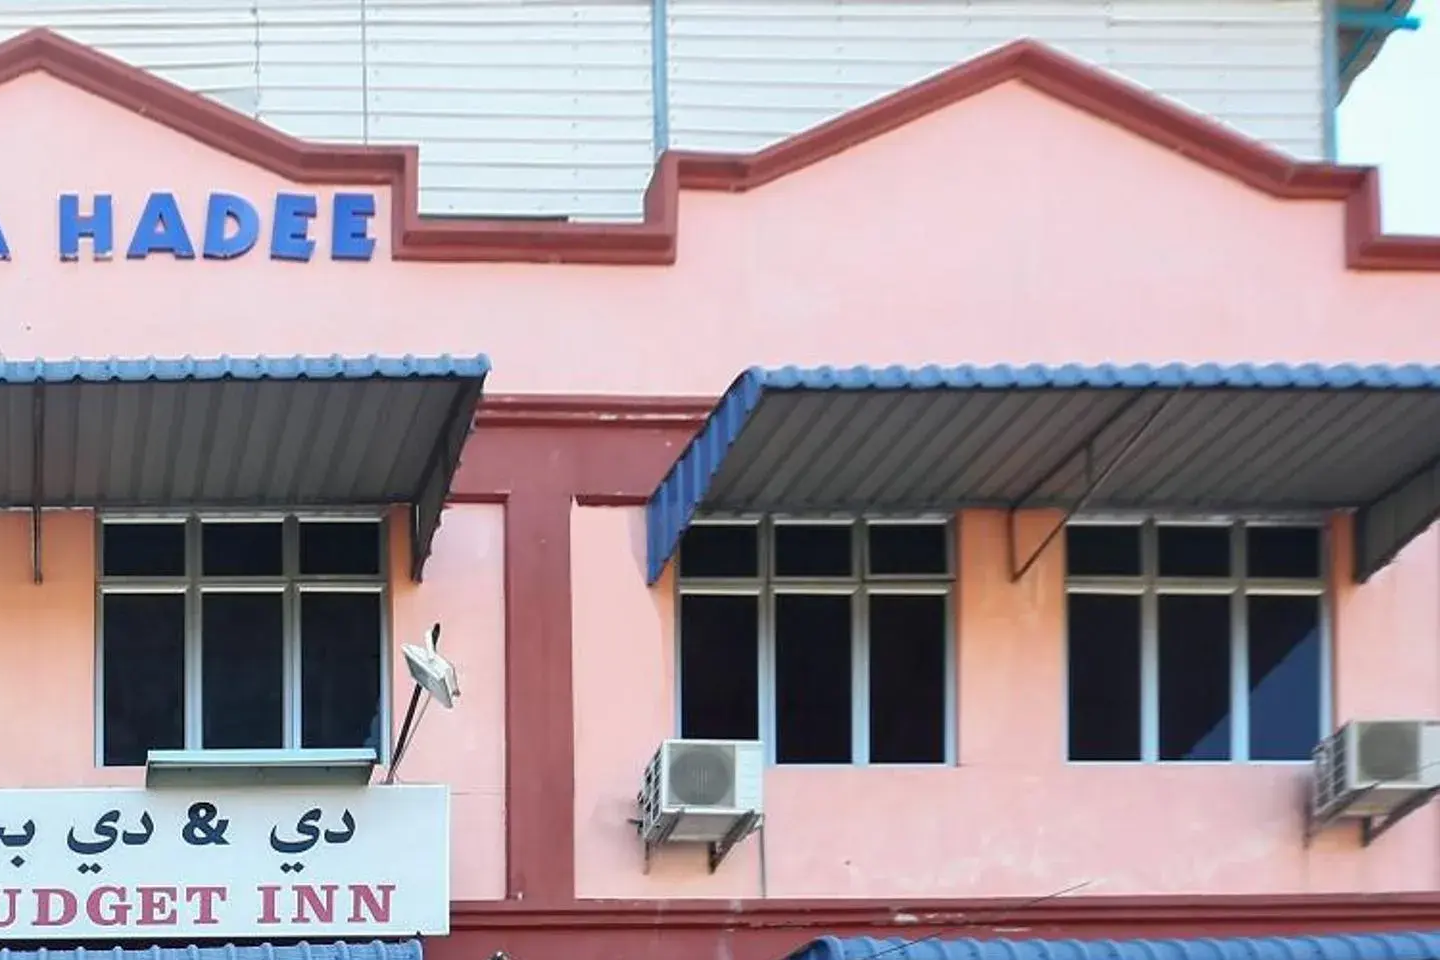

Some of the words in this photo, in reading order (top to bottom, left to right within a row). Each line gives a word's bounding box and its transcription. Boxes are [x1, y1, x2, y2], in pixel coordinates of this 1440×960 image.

[59, 191, 378, 263] HADEE
[66, 808, 155, 875] دي
[181, 801, 231, 846] &
[269, 807, 357, 874] دي
[257, 884, 397, 925] INN
